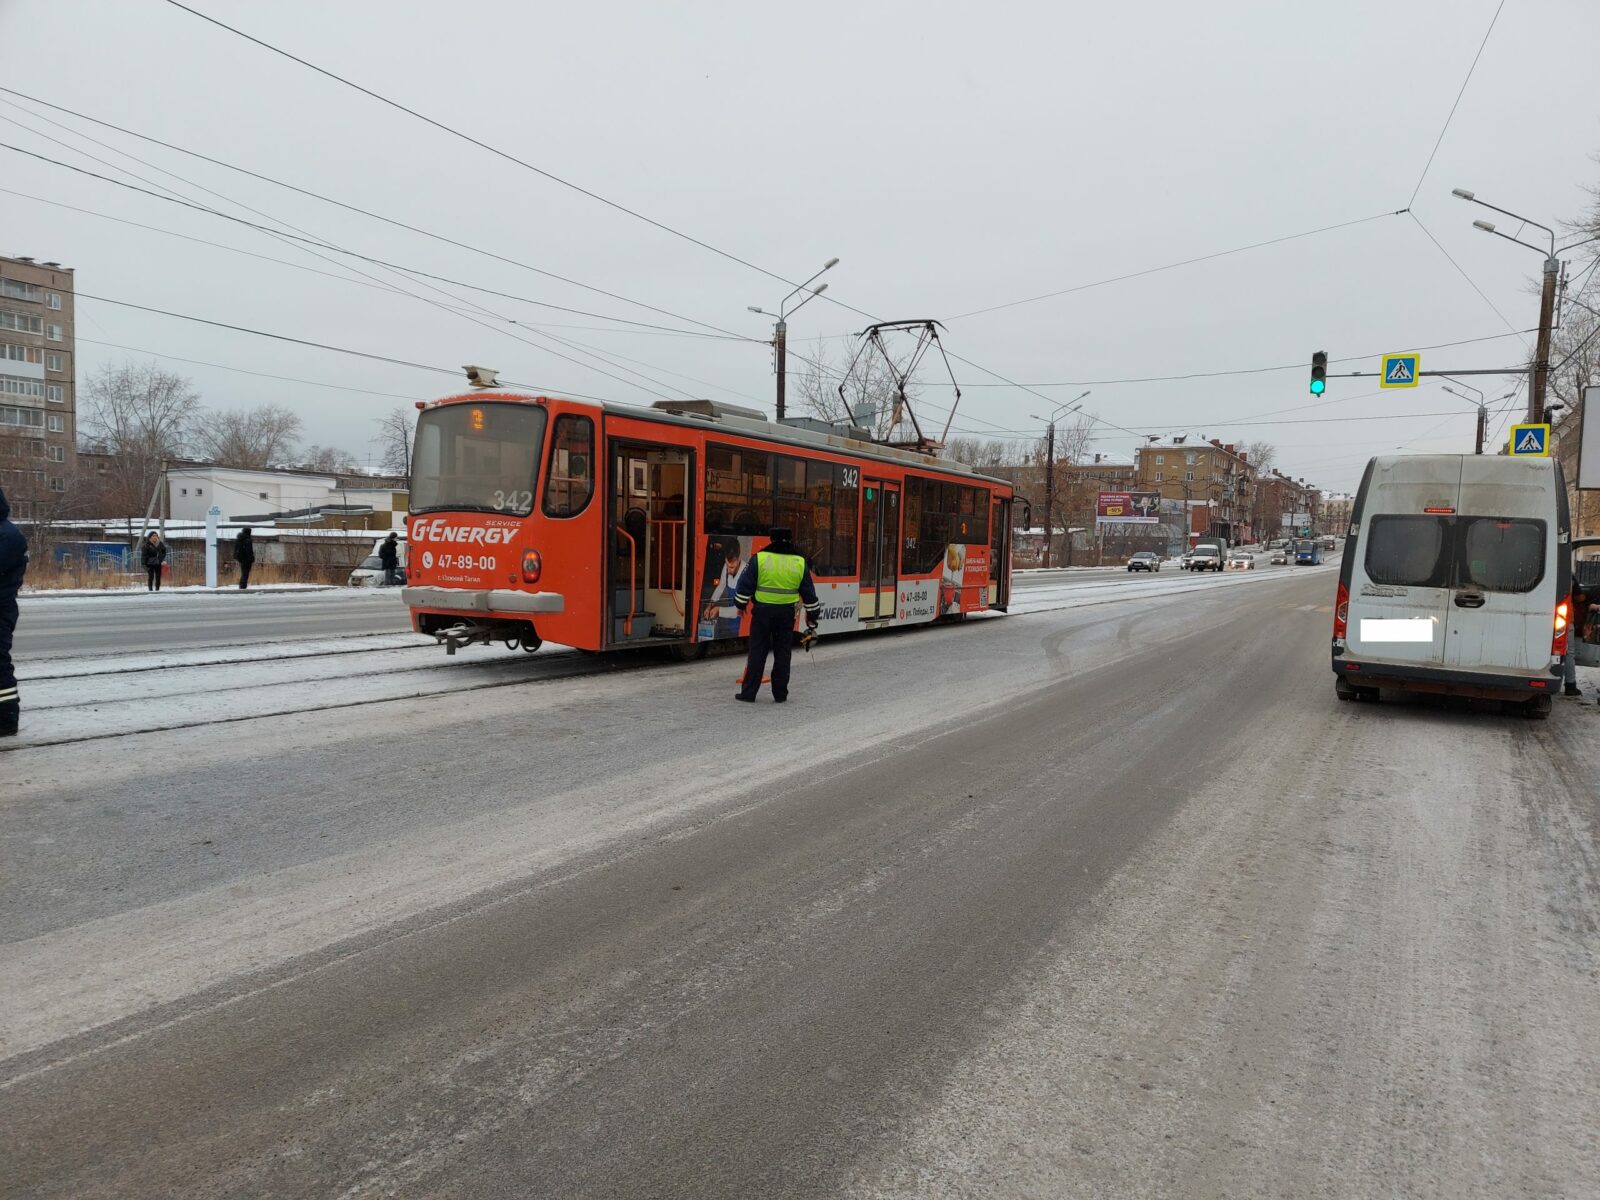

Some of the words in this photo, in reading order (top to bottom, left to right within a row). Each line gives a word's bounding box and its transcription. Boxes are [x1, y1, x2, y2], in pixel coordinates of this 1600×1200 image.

[842, 468, 858, 488] 342
[494, 490, 532, 511] 342
[905, 537, 917, 549] 342
[438, 554, 497, 570] 47-89-00
[906, 591, 928, 602] 47-89-00
